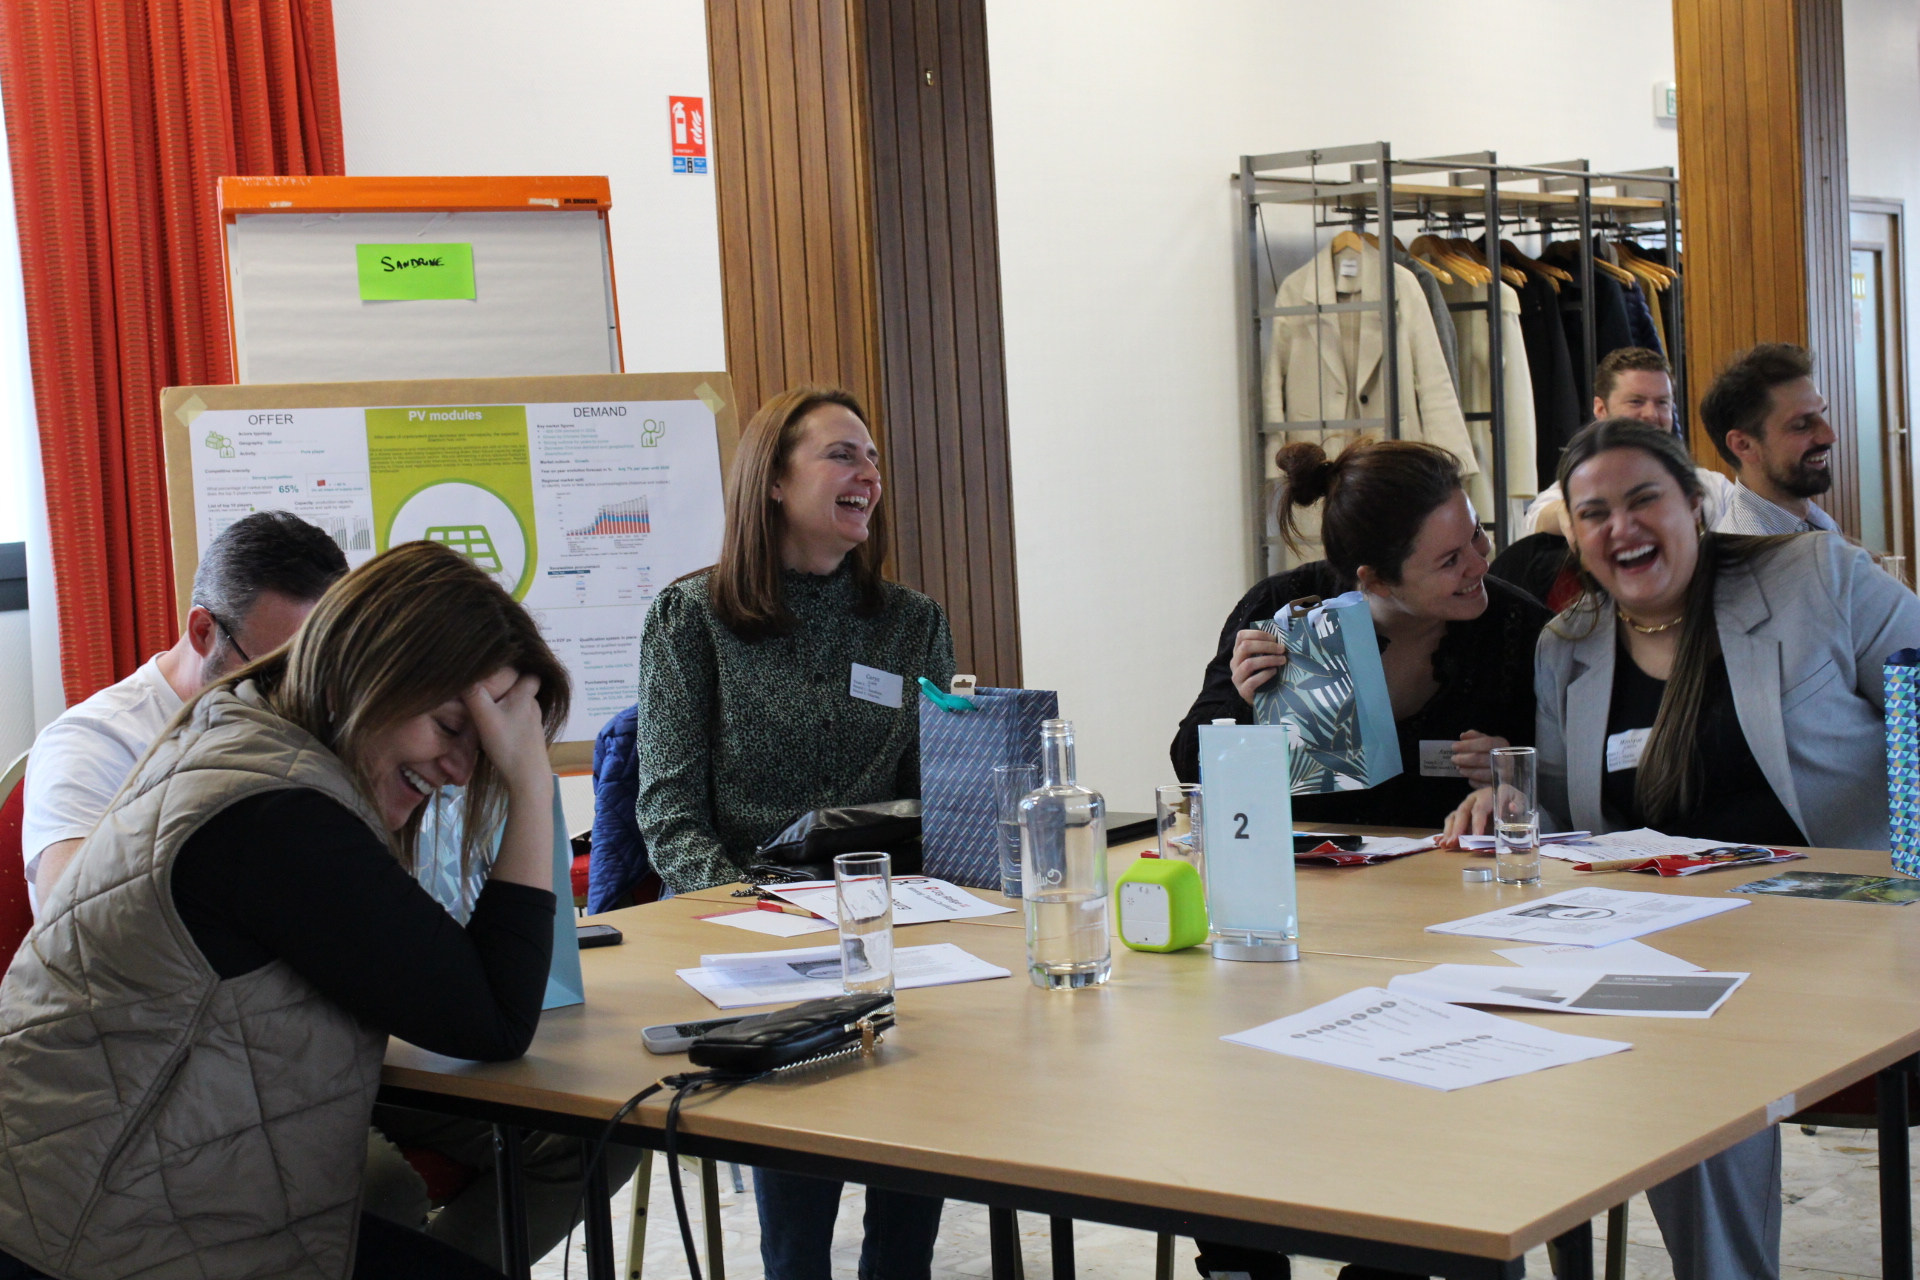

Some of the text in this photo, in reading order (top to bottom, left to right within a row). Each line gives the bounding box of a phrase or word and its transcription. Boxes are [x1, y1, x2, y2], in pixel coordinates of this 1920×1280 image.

[408, 409, 483, 422] PV modules
[573, 406, 627, 418] DEMAND
[248, 414, 293, 426] OFFER
[278, 485, 299, 493] 65%
[1233, 812, 1250, 840] 2
